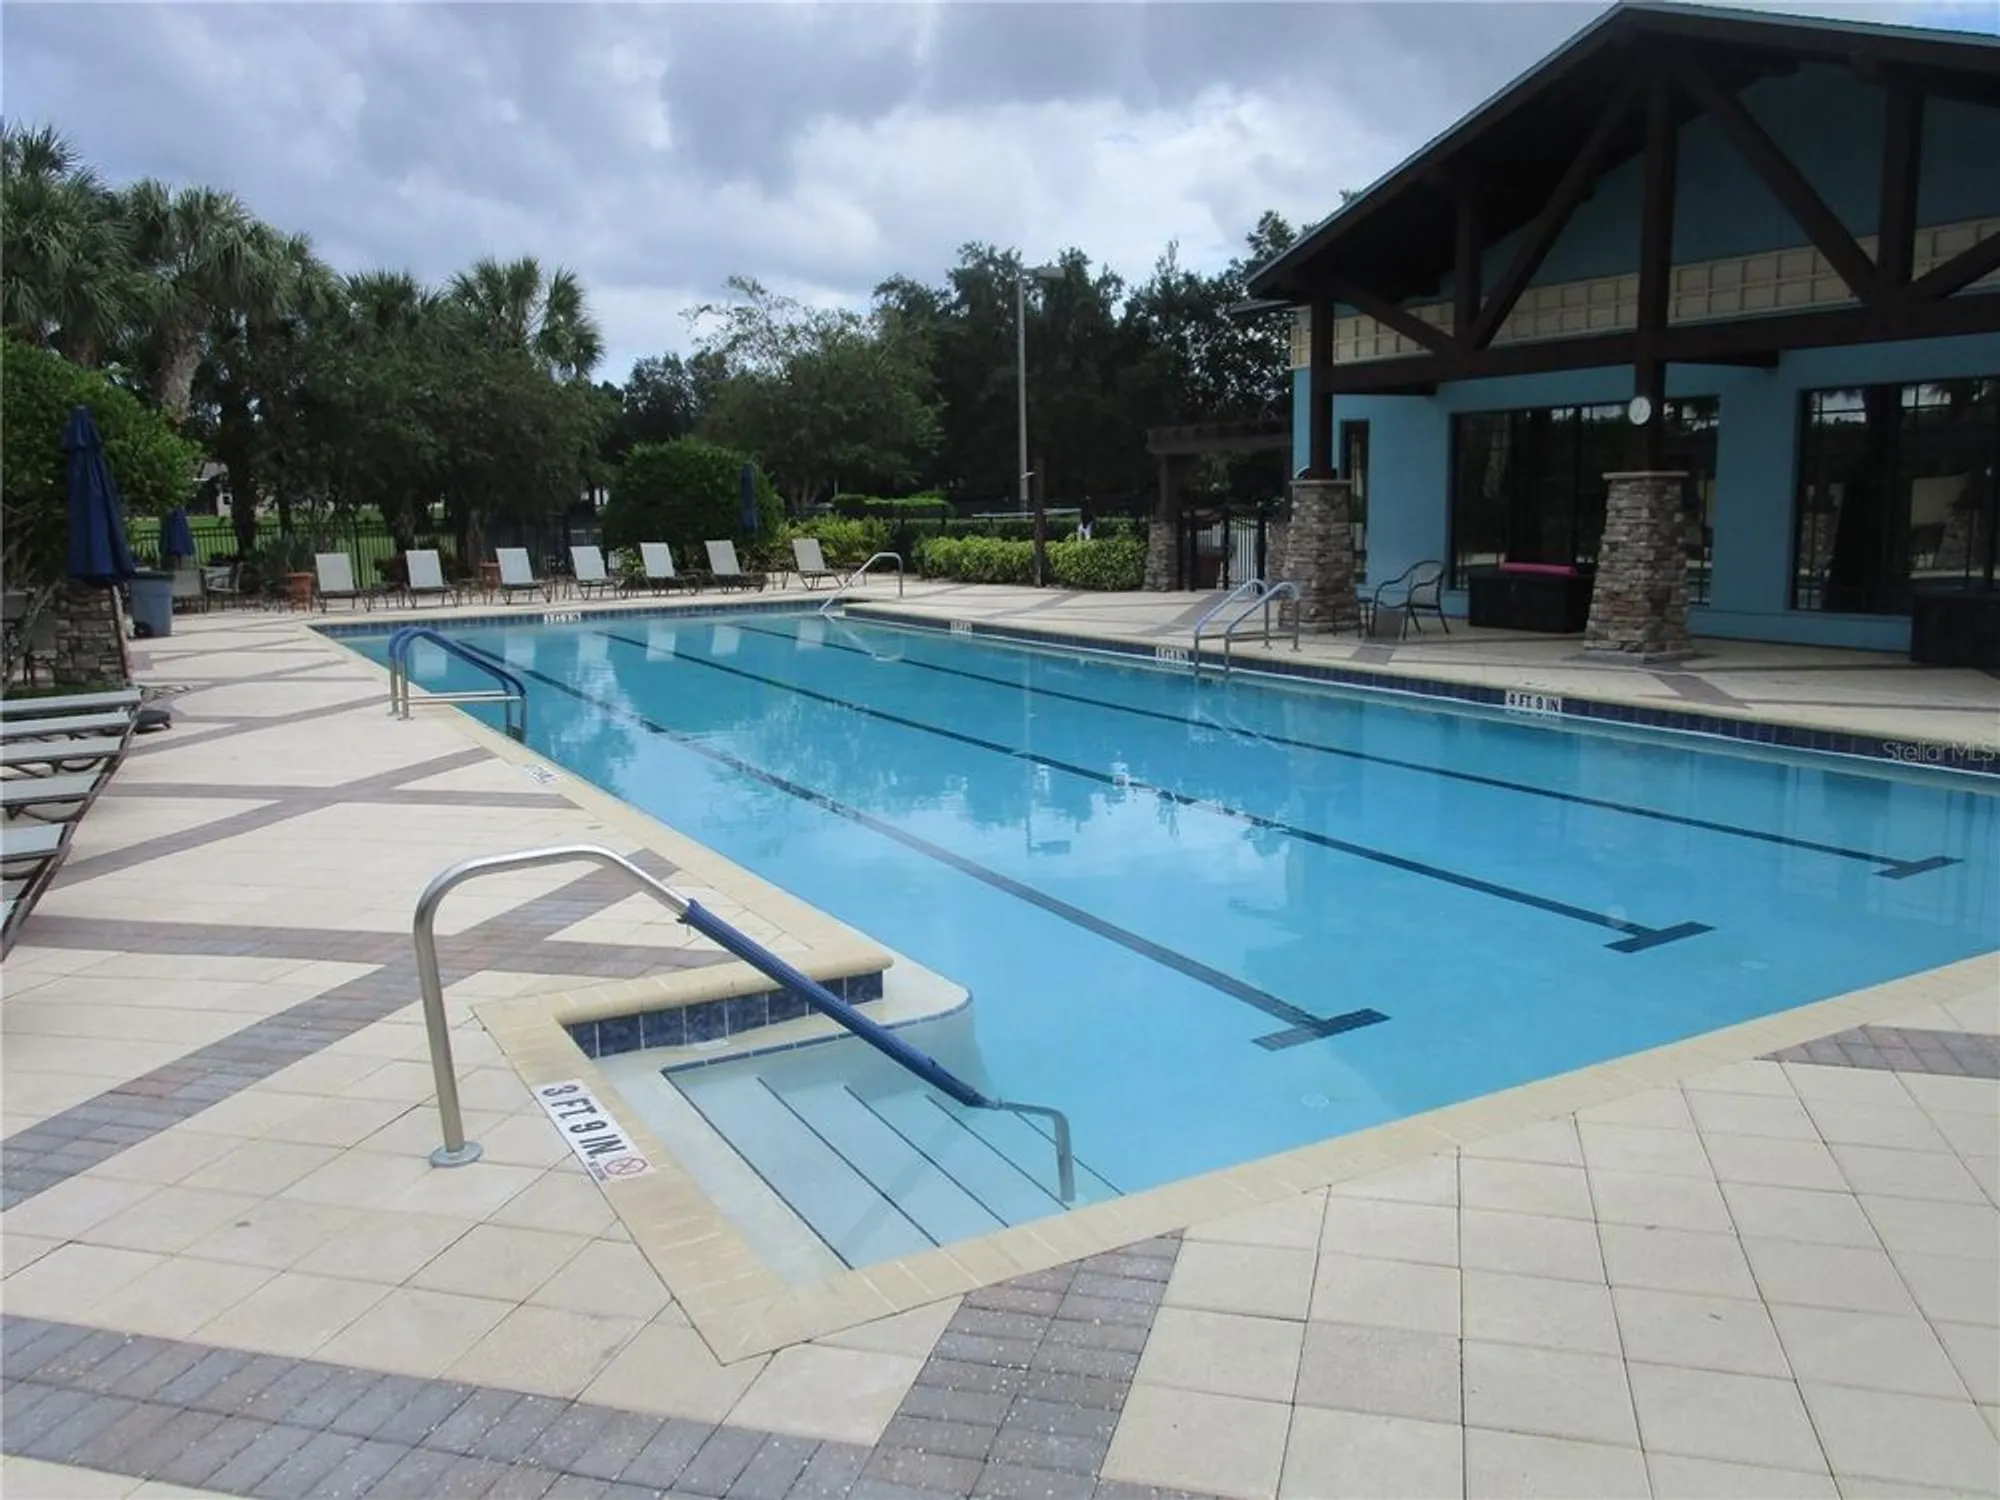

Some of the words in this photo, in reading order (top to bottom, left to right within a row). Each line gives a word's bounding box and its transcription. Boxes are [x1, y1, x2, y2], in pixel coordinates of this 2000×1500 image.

[1519, 694, 1532, 708] FT
[541, 1084, 580, 1098] 3
[550, 1098, 598, 1120] FT
[568, 1120, 608, 1134] 9
